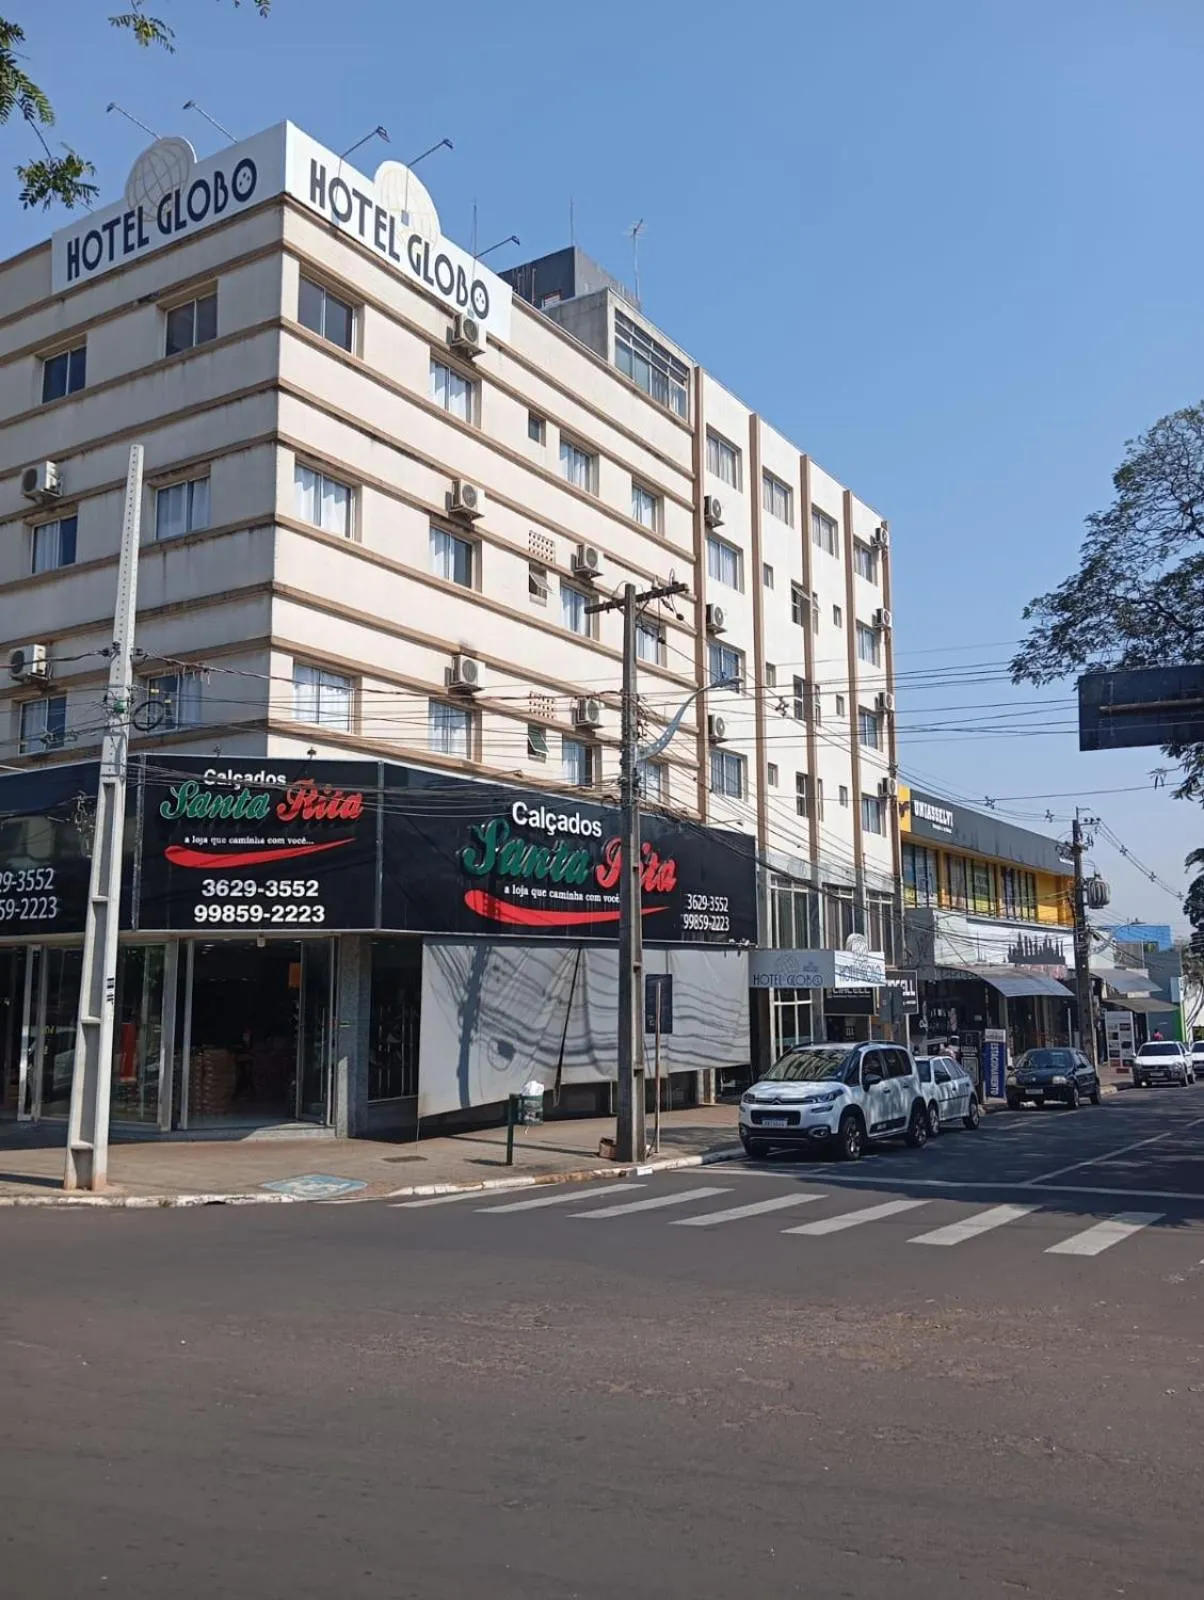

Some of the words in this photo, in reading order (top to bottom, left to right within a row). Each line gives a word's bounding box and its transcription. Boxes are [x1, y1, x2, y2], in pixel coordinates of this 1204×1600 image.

[66, 205, 150, 282] HOTEL
[157, 158, 257, 235] GLOBO
[309, 158, 401, 261] HOTEL
[407, 233, 490, 320] GLOBO
[203, 768, 286, 789] Calçados
[159, 780, 271, 820] Santa
[276, 778, 365, 821] Rita
[512, 801, 602, 837] Calçados
[192, 836, 208, 846] loja
[211, 837, 226, 845] que
[228, 836, 265, 844] caminha
[462, 818, 592, 885] Santa
[0, 868, 54, 893] 9-3552
[201, 879, 319, 898] 3629-3552
[512, 884, 529, 898] loja
[531, 887, 547, 900] que
[549, 888, 583, 902] caminha
[585, 893, 601, 902] com
[687, 894, 729, 911] 3629-3552
[194, 905, 325, 923] 99859-2223
[683, 913, 730, 931] 99859-2223
[753, 973, 781, 986] HOTEL
[787, 973, 823, 987] GLOBO
